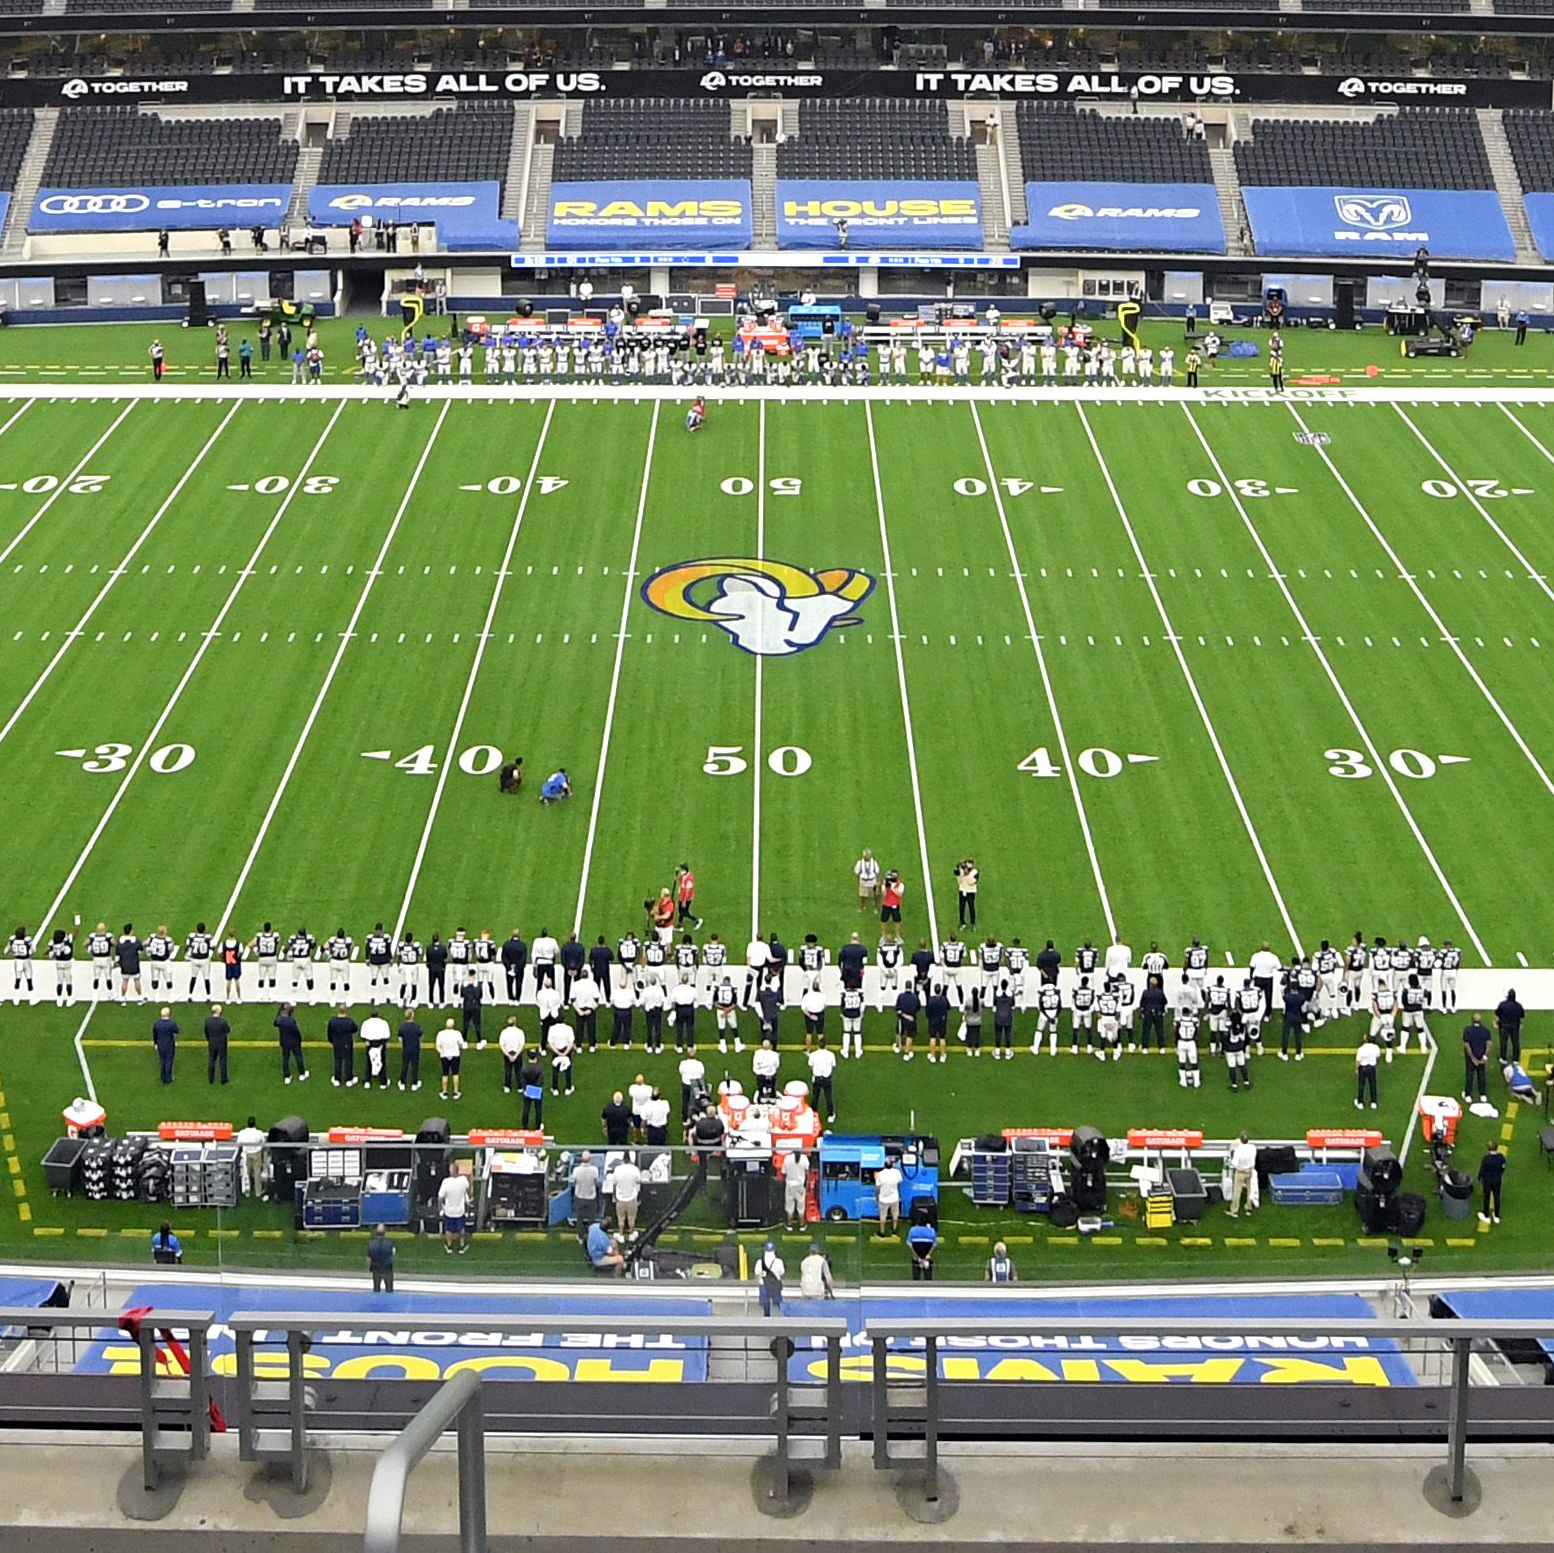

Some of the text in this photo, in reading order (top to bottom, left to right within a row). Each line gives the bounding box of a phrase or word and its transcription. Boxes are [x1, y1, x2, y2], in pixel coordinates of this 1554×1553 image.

[91, 80, 189, 95] TOGETHER
[283, 72, 607, 95] IT TAKES ALL OF US.
[728, 74, 823, 88] TOGETHER
[916, 72, 1242, 96] IT TAKES ALL OF US.
[1366, 81, 1468, 96] TOGETHER
[376, 194, 476, 210] RAMS
[553, 200, 744, 218] RAMS
[783, 199, 977, 217] HOUSE
[552, 215, 743, 228] HONORS THOSE ON
[784, 217, 830, 226] THE
[912, 216, 979, 225] LINES
[1093, 205, 1202, 221] RAMS
[1332, 230, 1429, 243] RAM
[10, 474, 112, 494] 20
[244, 475, 342, 495] 30
[485, 475, 570, 496] 40
[719, 476, 803, 497] 50
[952, 477, 1036, 497] 40
[1185, 478, 1272, 499] 30
[1420, 478, 1511, 500] 20
[80, 743, 199, 773] 30
[393, 744, 505, 776] 40
[701, 745, 814, 778] 50
[1015, 746, 1122, 778] 40
[1323, 748, 1439, 780] 30
[369, 939, 387, 955] 75
[225, 950, 237, 966] K
[1324, 1138, 1367, 1147] GATORADE
[558, 1330, 687, 1349] THE
